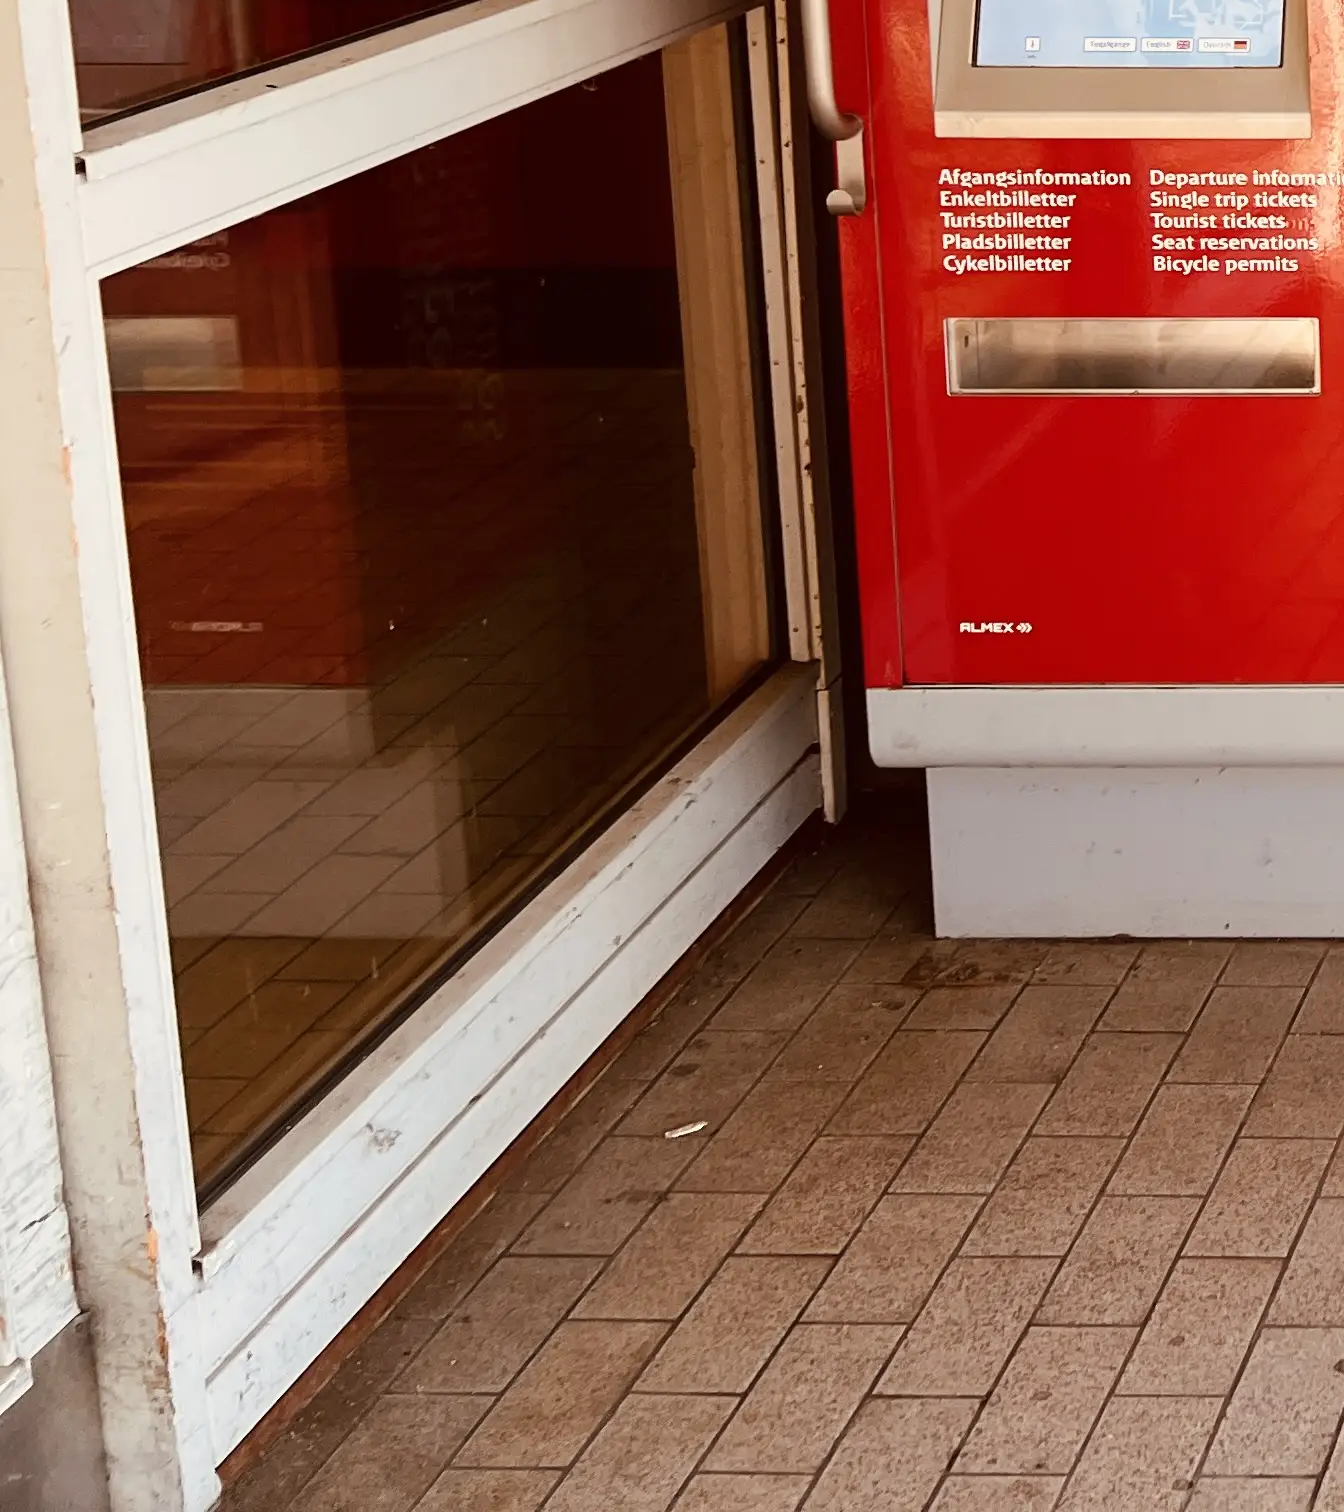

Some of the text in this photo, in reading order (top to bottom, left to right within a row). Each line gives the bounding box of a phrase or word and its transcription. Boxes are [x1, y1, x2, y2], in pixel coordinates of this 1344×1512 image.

[939, 169, 1131, 187] Afgangsinformation
[1149, 170, 1247, 188] Departure
[940, 190, 1077, 208] Enkeltbilletter
[1149, 191, 1317, 210] Single trip tickets
[940, 212, 1071, 229] Turistbilletter
[1150, 212, 1286, 230] Tourist tickets
[942, 233, 1072, 250] Pladsbilletter
[1151, 234, 1319, 252] Seat reservations
[943, 255, 1072, 274] Cykelbilletter
[1153, 256, 1299, 274] Bicycle permits
[959, 621, 1015, 634] ALMEX
